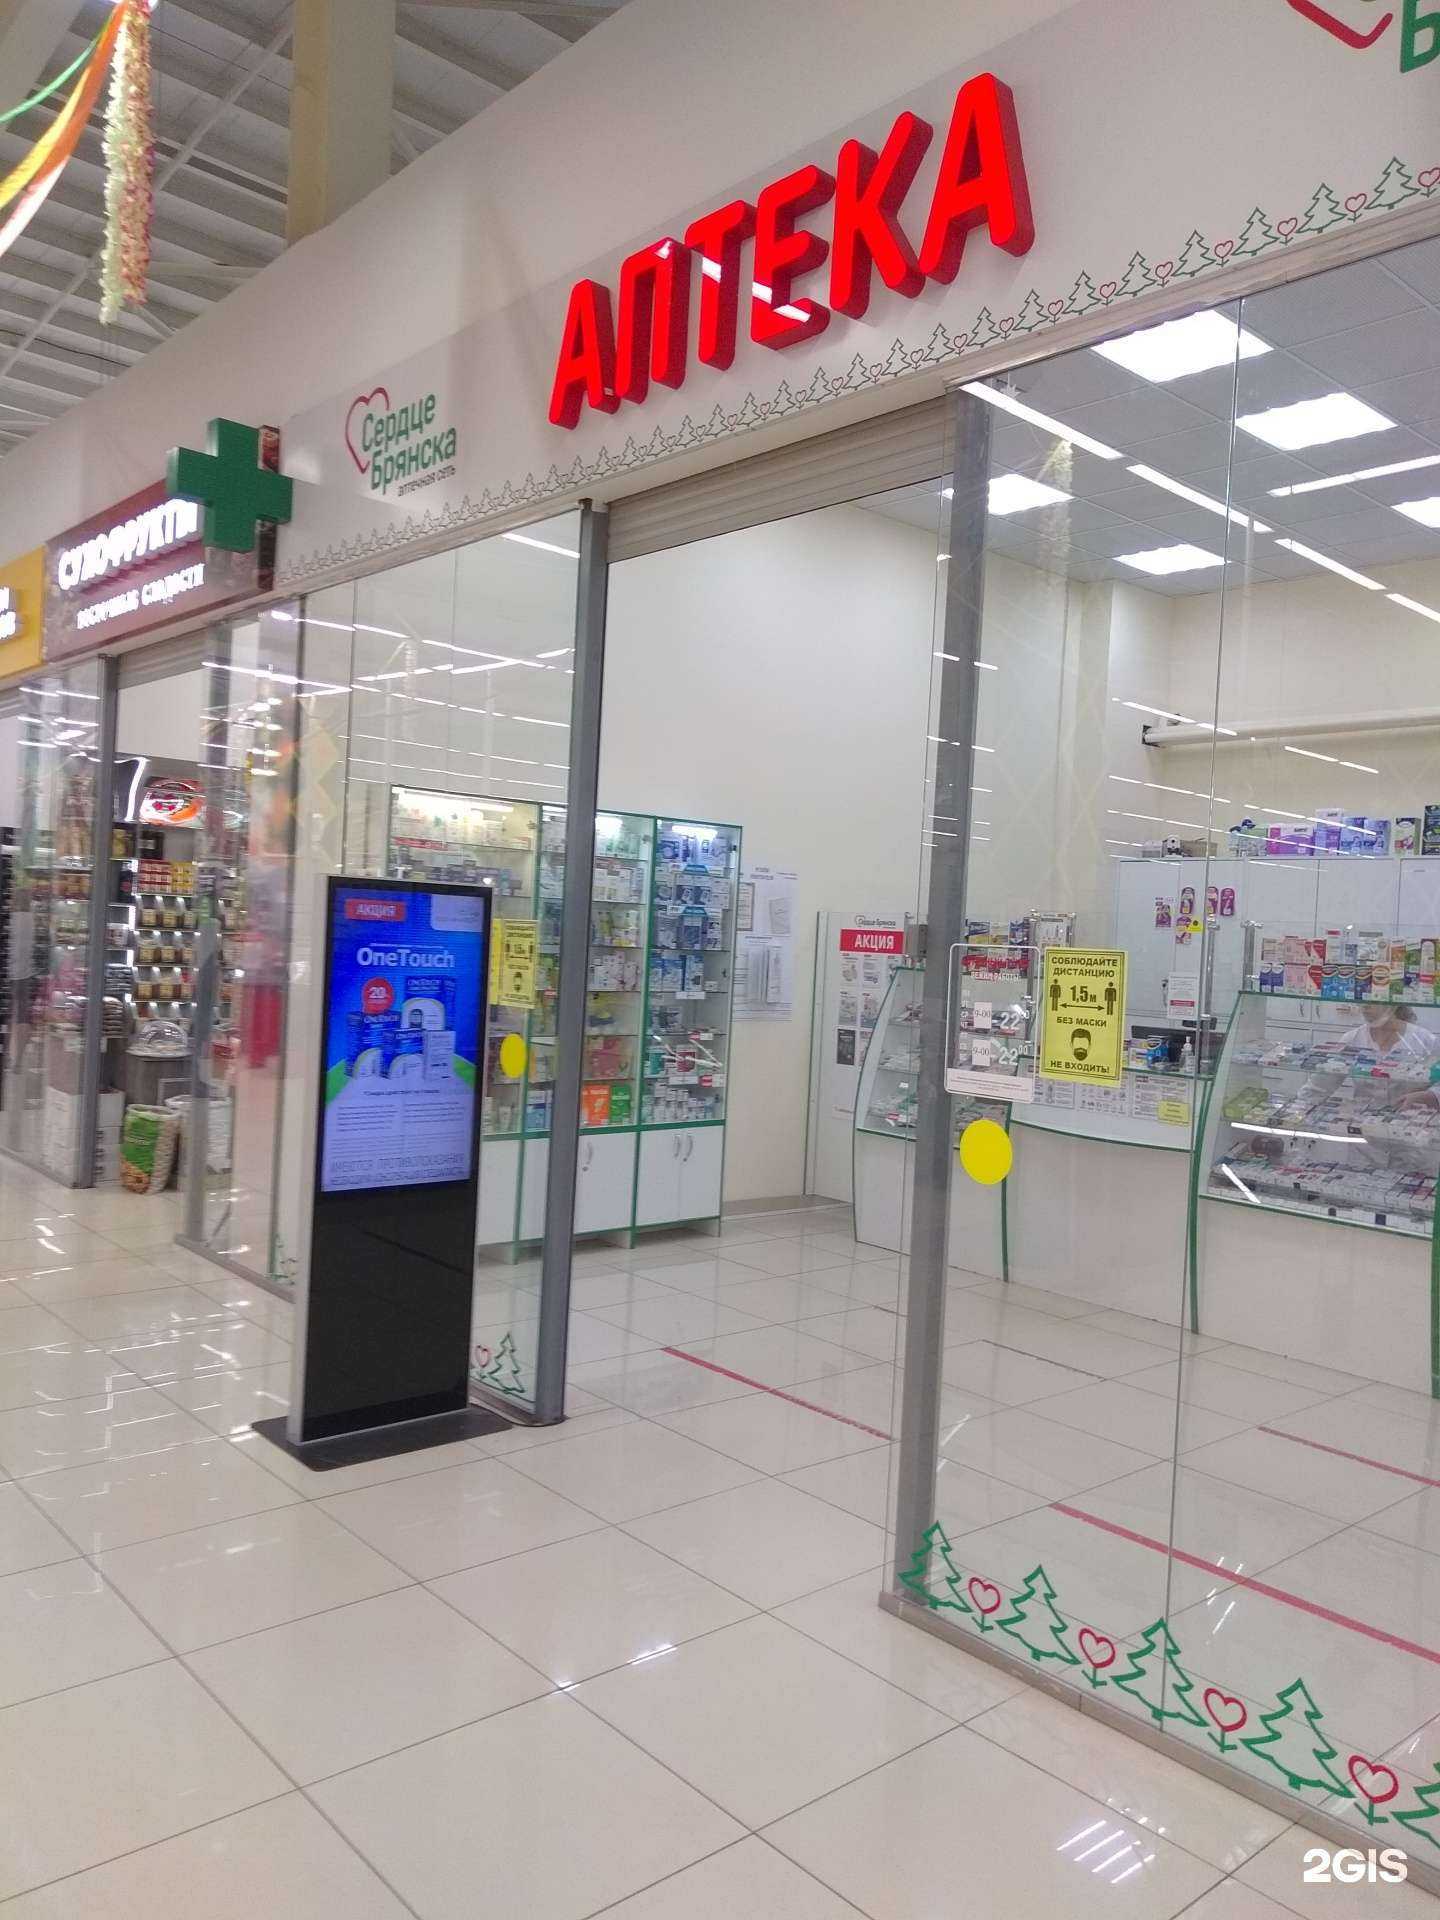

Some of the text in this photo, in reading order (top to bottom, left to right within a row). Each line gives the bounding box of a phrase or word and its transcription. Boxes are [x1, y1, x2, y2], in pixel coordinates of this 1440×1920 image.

[549, 72, 1035, 430] АПТЕКА
[362, 393, 436, 452] Сердце
[371, 427, 457, 495] Брянска
[355, 903, 397, 918] АКЦИЯ
[854, 934, 895, 951] АКЦИЯ
[356, 946, 456, 968] OneTouch
[1051, 956, 1118, 968] СОБЛЮДАЙТЕ
[1053, 967, 1115, 979] ДИСТАНЦИЮ
[1070, 985, 1089, 1003] 1,5
[1000, 1011, 1020, 1031] 22
[1056, 1016, 1108, 1028] БЕЗ МАСКИ
[998, 1047, 1018, 1066] 22
[1050, 1059, 1110, 1075] НЕ ВХОДИТЬ!
